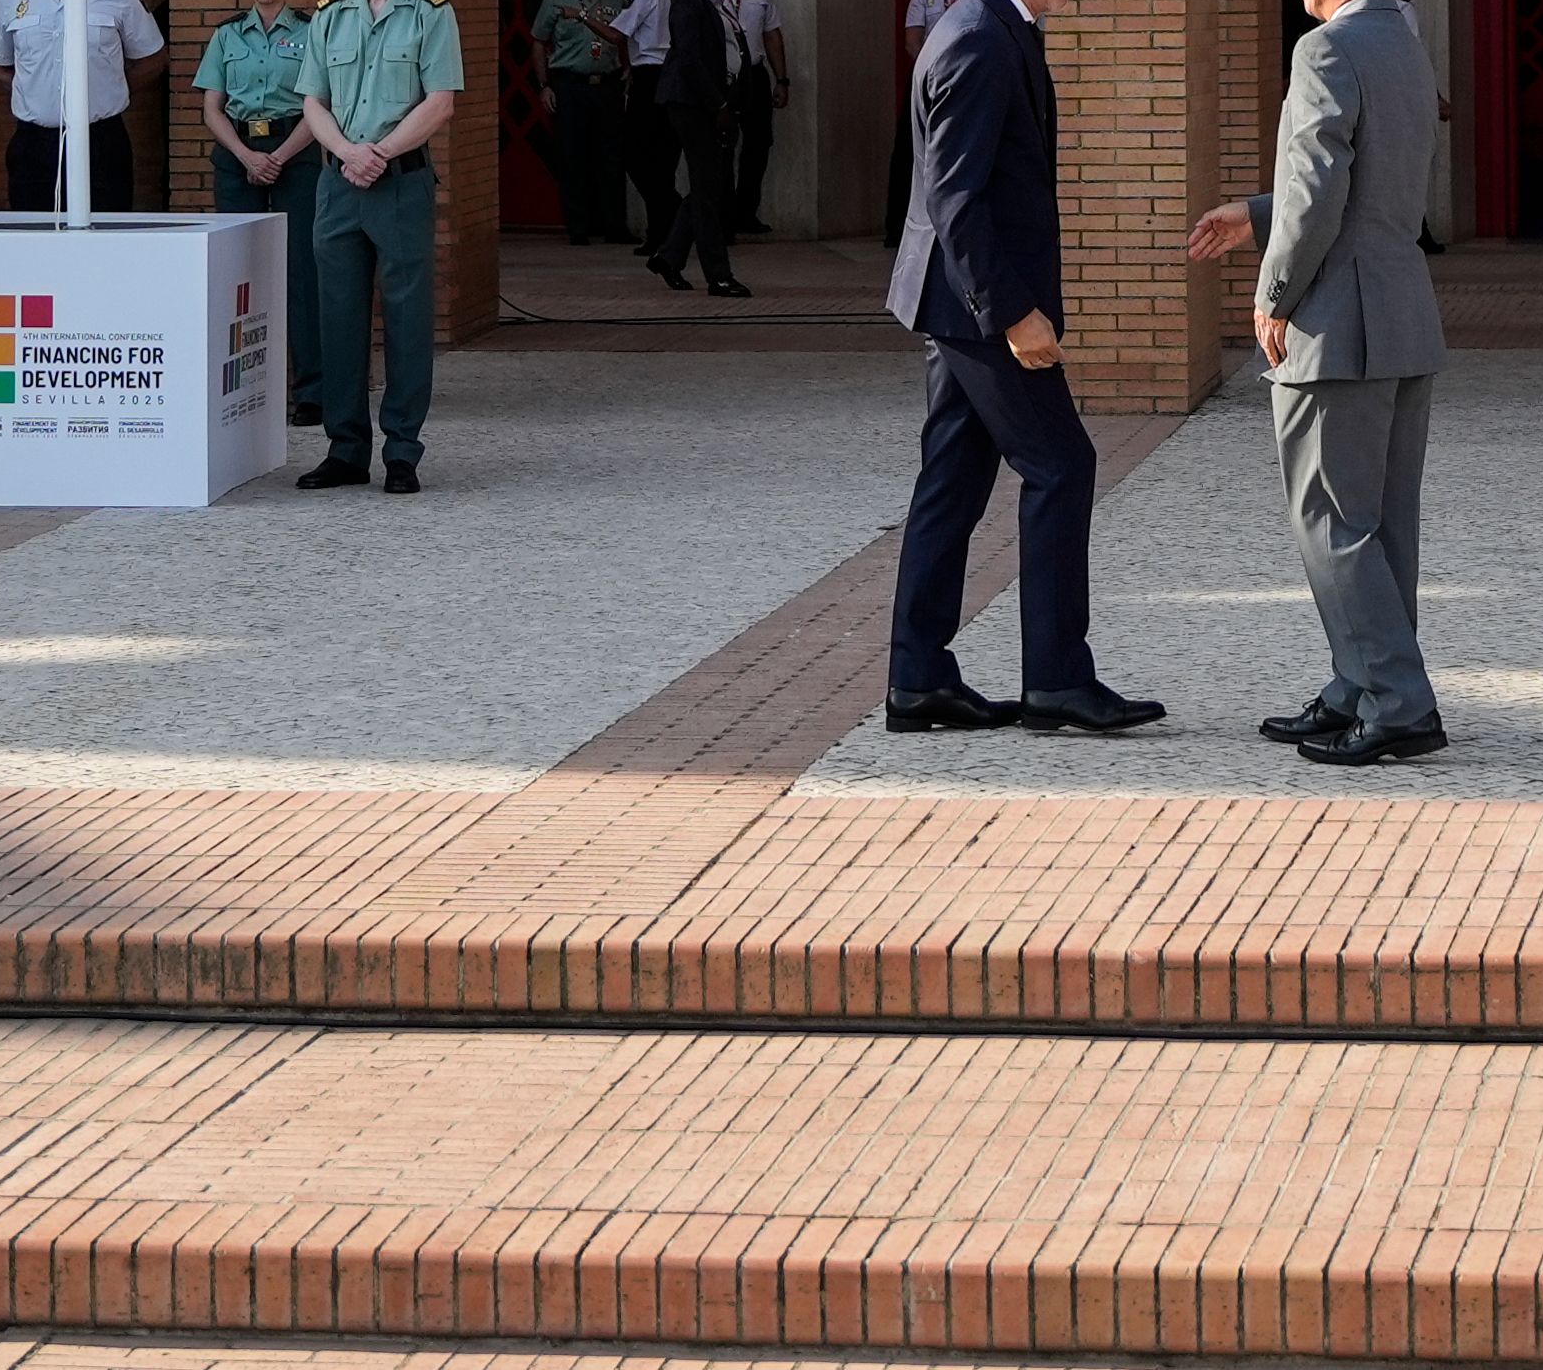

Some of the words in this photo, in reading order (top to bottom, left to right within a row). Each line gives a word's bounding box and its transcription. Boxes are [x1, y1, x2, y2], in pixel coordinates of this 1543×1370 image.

[109, 333, 163, 341] CONFERENCE
[23, 347, 121, 364] FINANCING
[129, 348, 163, 364] FOR
[23, 371, 163, 388] DEVELOPMENT
[22, 395, 105, 404] SEVILLA
[120, 395, 164, 405] 2025
